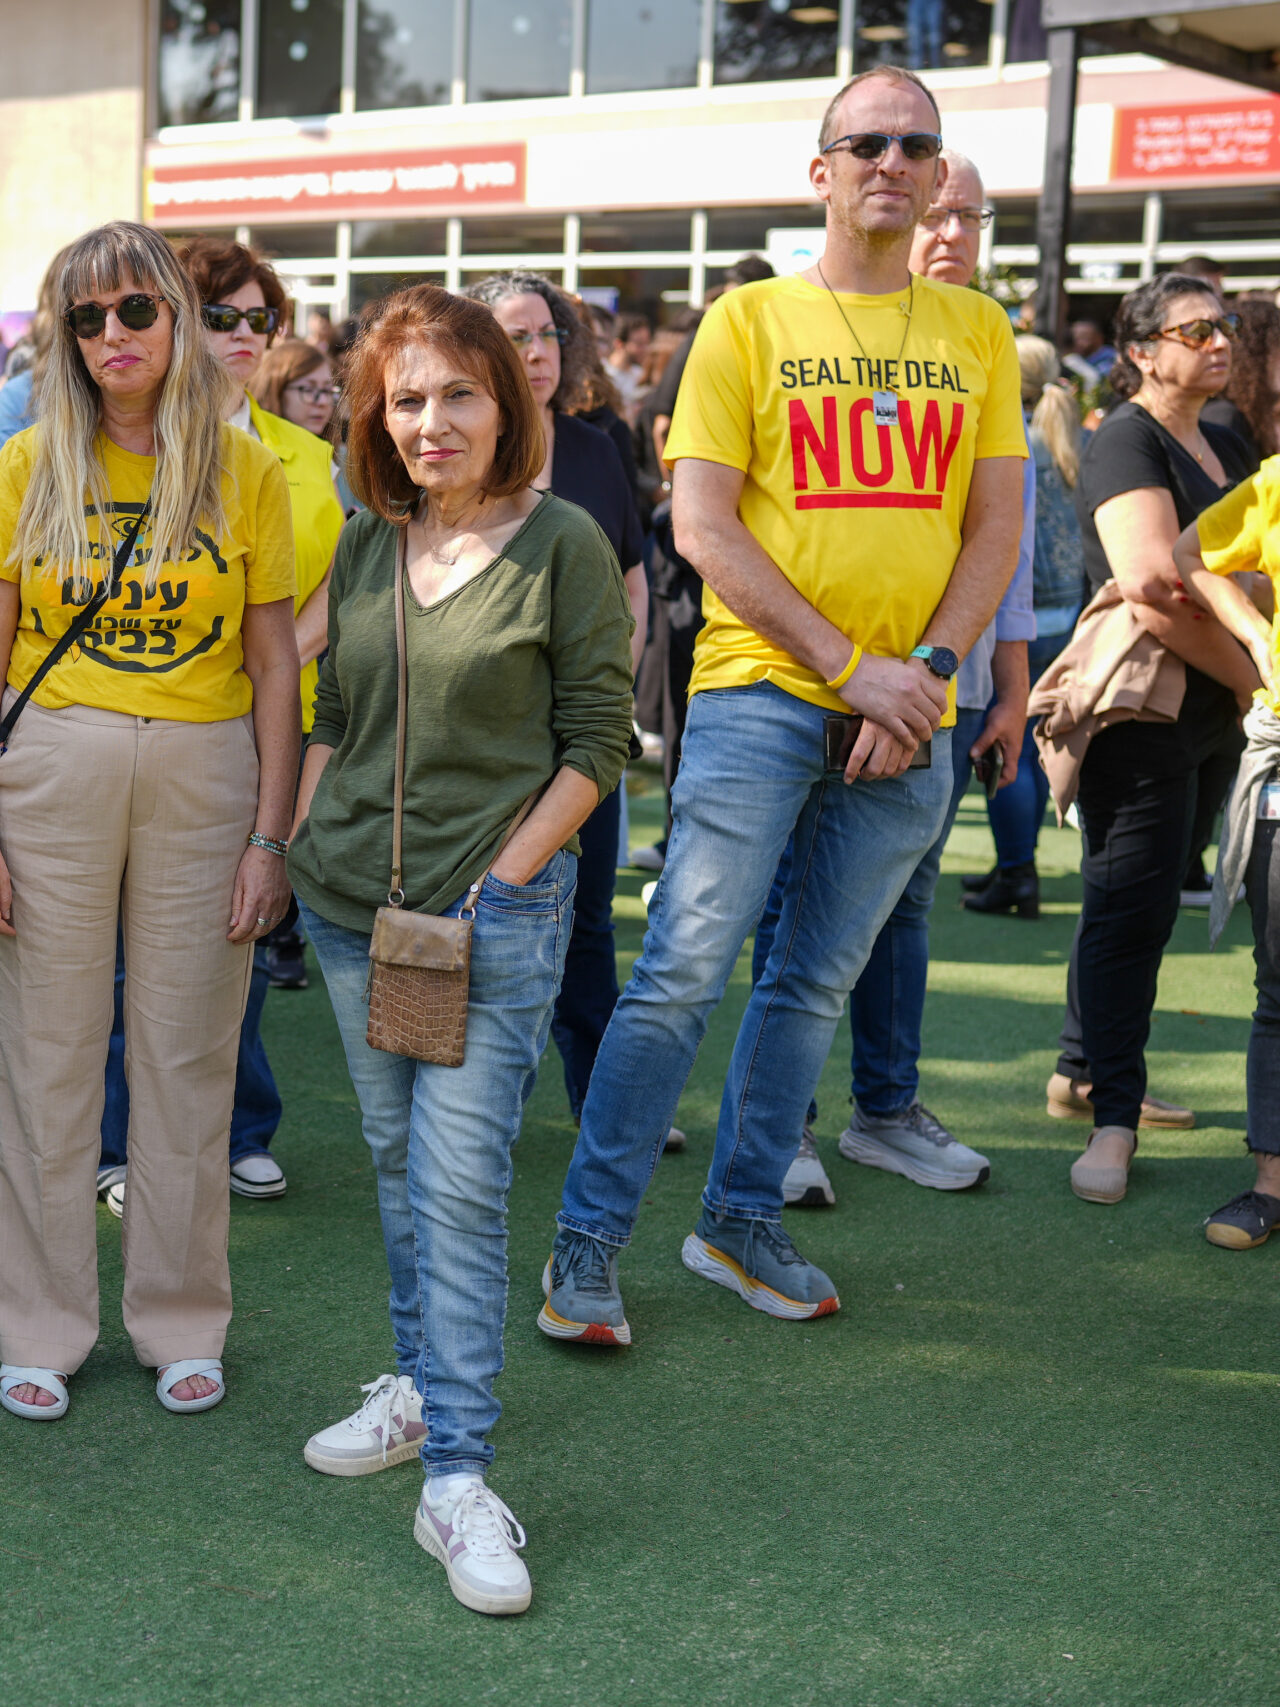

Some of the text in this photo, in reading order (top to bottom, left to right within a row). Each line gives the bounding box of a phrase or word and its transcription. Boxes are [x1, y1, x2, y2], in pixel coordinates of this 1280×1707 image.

[780, 357, 969, 393] SEAL THE DEAL
[788, 396, 965, 491] NOW
[72, 615, 182, 630] עד שכו
